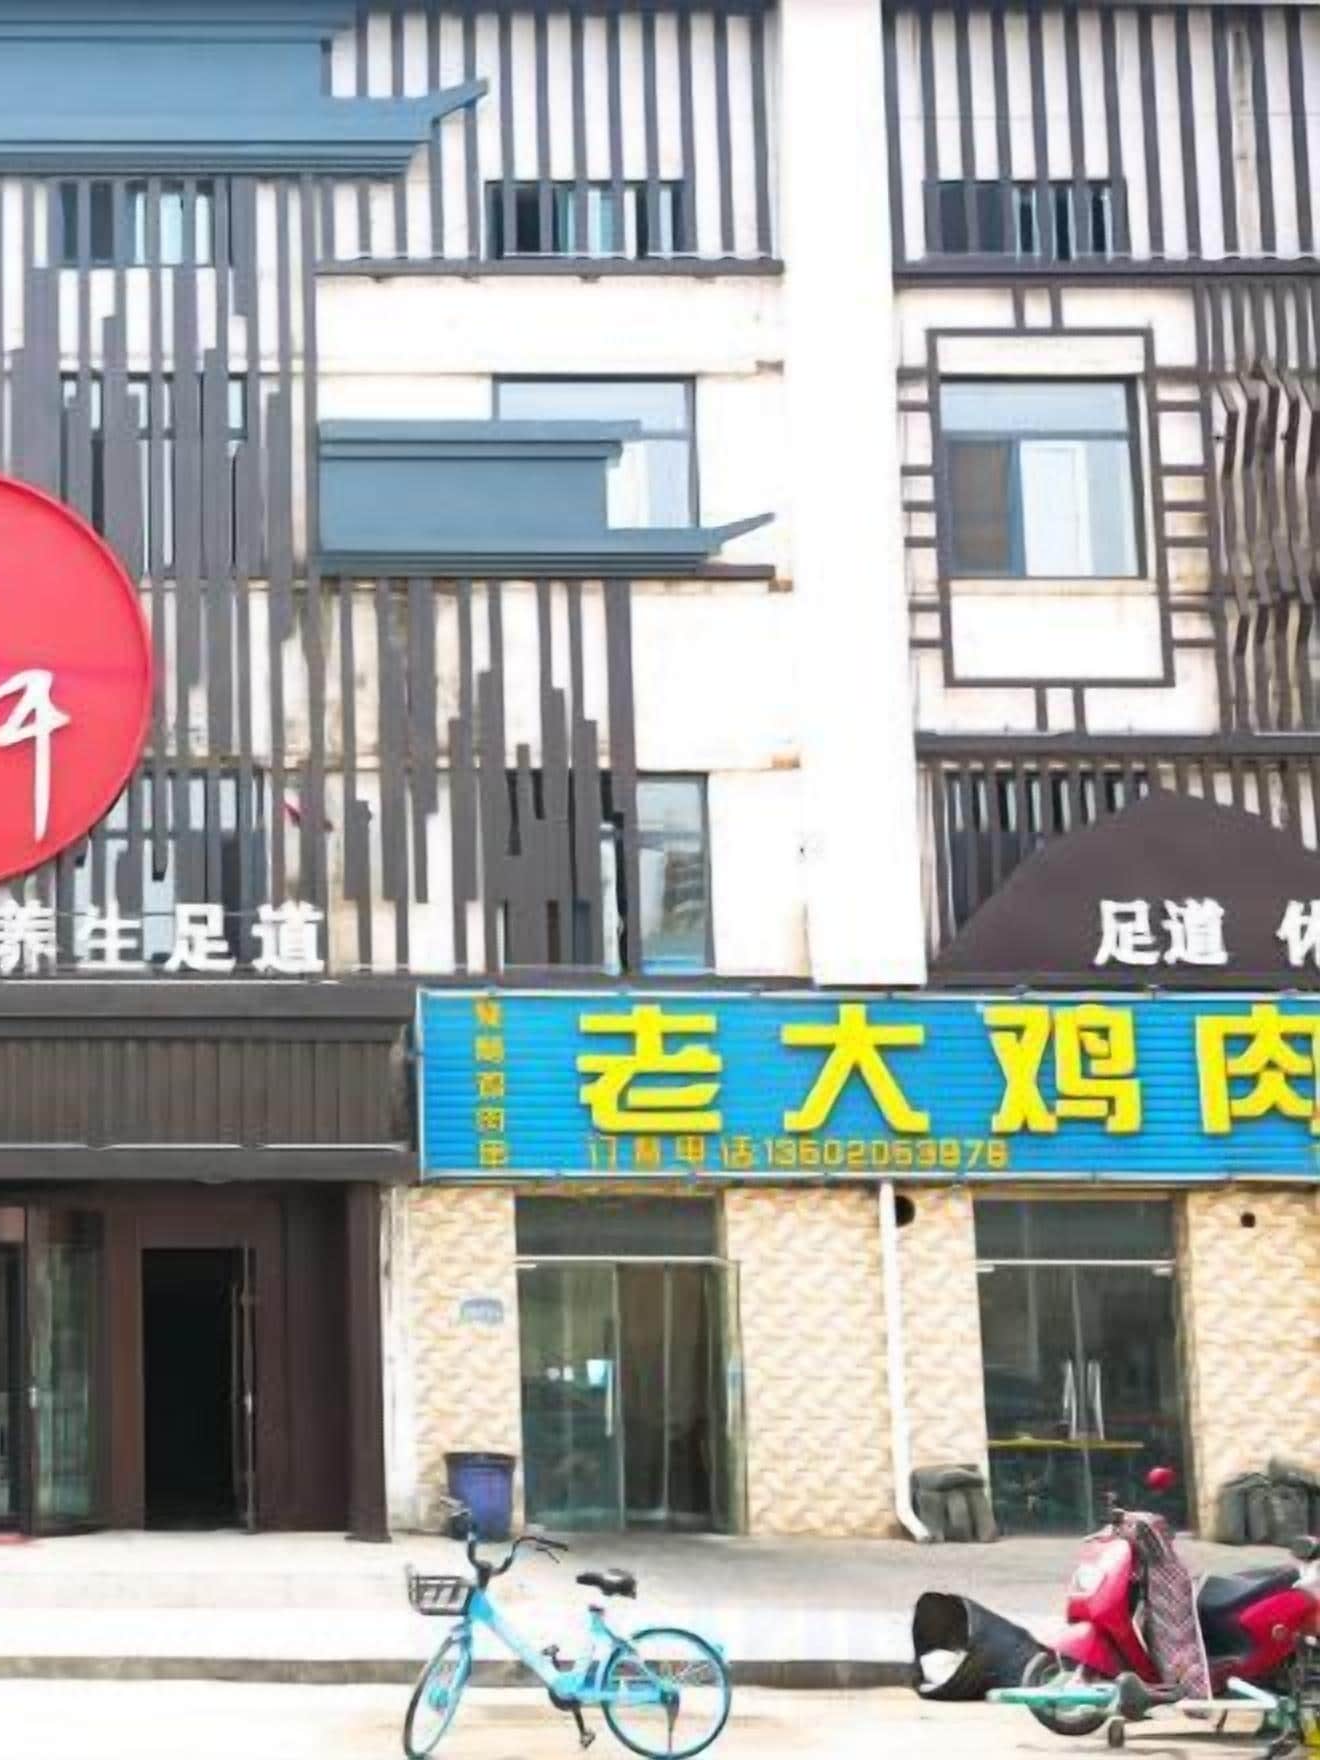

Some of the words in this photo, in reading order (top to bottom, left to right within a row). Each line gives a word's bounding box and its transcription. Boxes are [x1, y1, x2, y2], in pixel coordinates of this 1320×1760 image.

[1094, 898, 1228, 966] 足道
[576, 1003, 1320, 1134] 老大鸡肉
